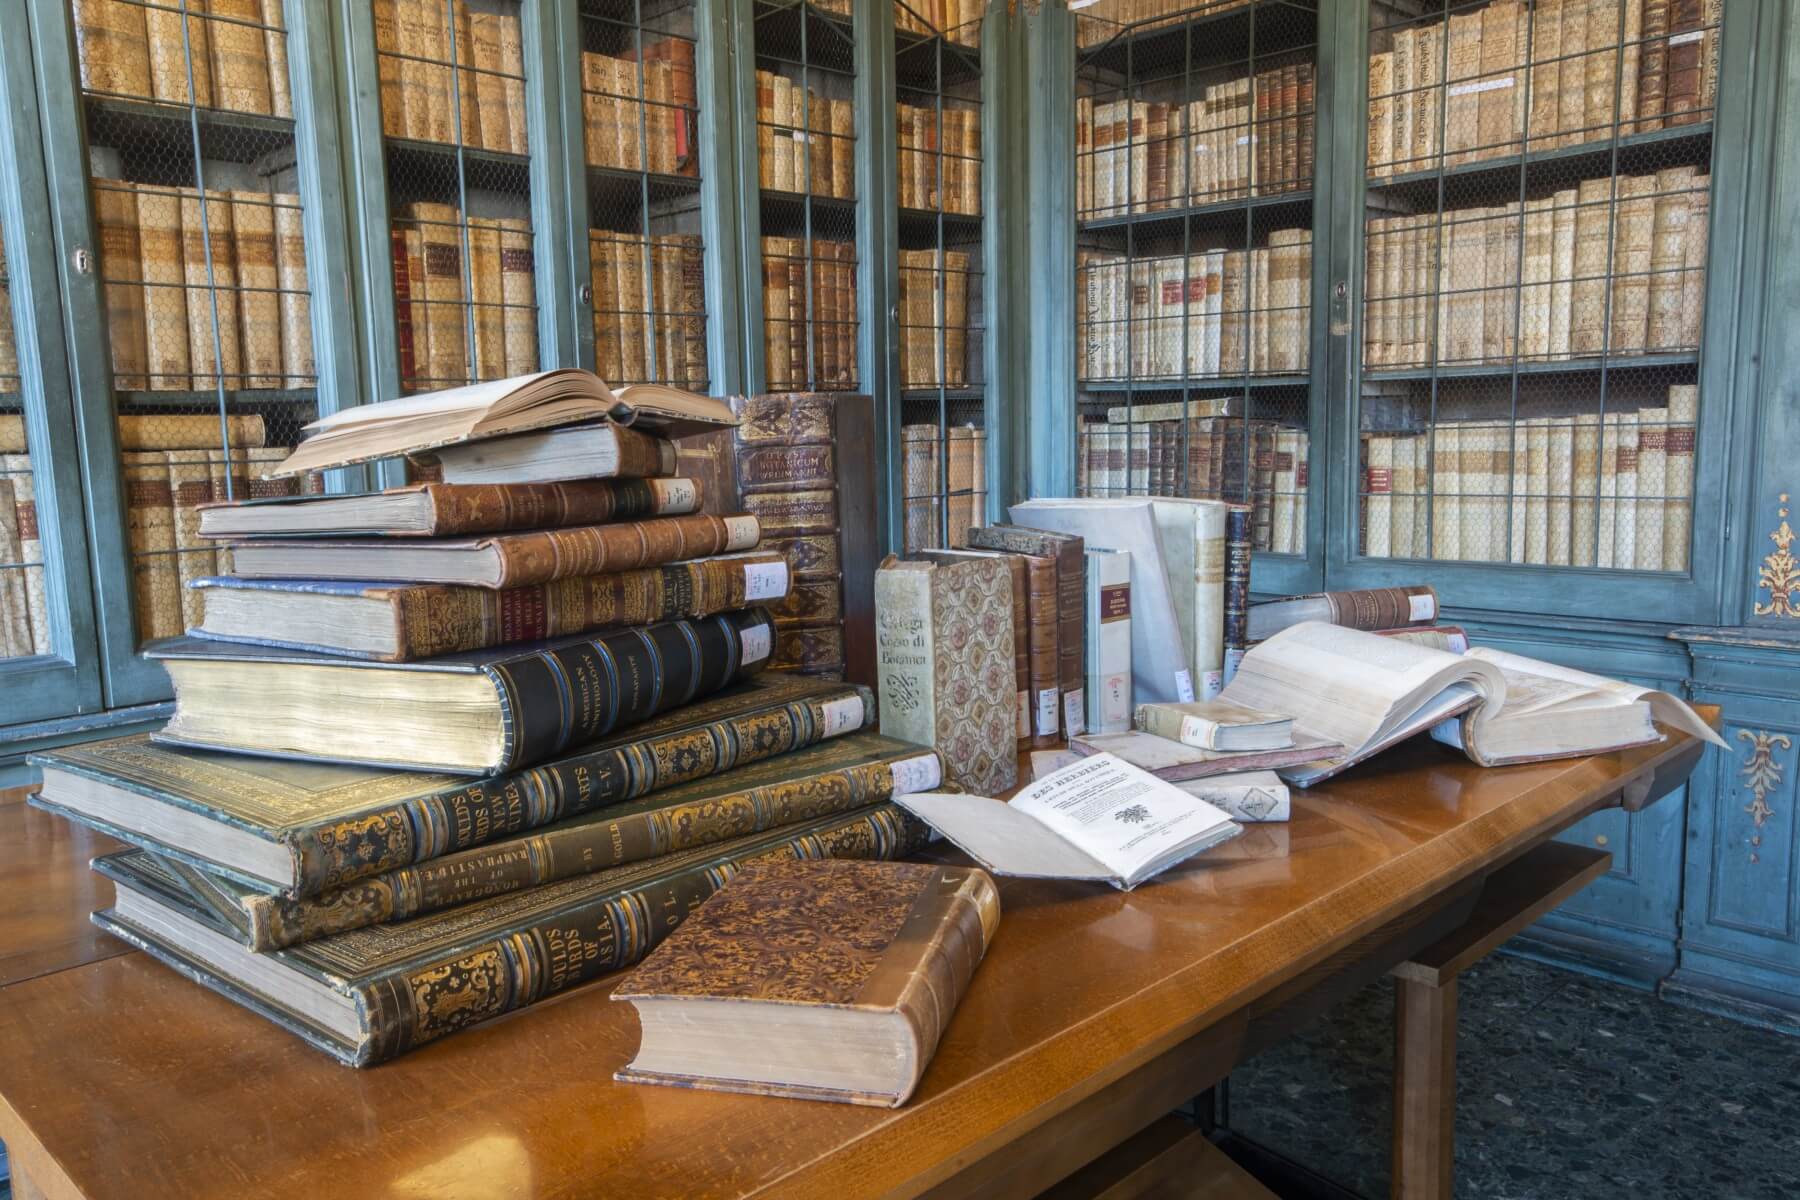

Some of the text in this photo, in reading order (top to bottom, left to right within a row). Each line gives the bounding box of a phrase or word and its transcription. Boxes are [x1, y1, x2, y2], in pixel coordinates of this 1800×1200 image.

[913, 634, 925, 647] di
[576, 666, 590, 728] AMERICAN
[467, 787, 484, 803] OF
[489, 795, 506, 832] NEW
[583, 847, 593, 861] BY
[609, 823, 623, 859] GOULD
[564, 927, 583, 981] BIRDS
[584, 941, 599, 960] OF
